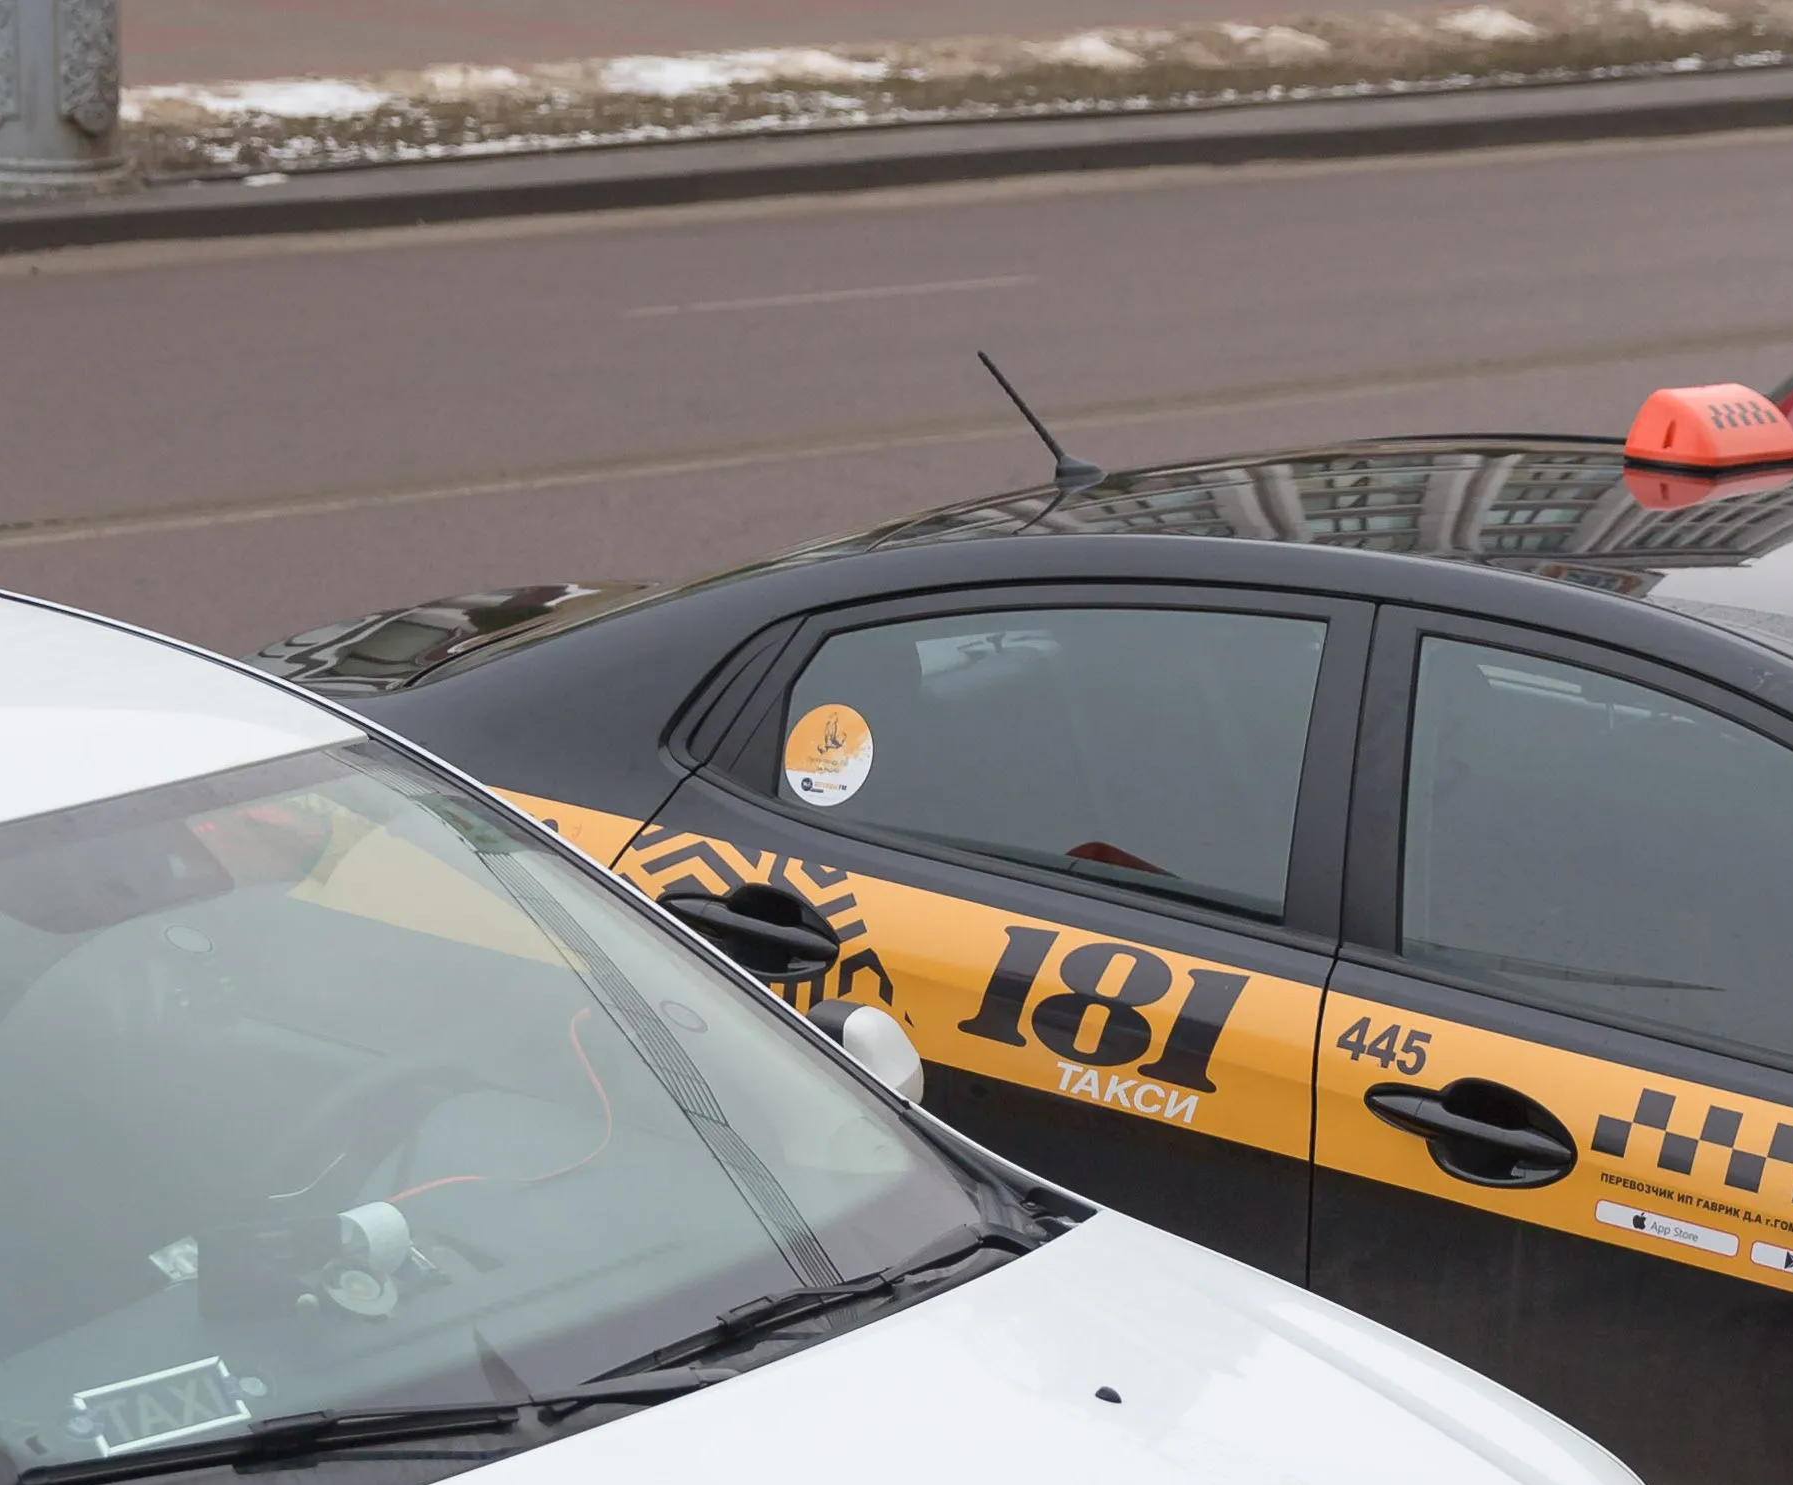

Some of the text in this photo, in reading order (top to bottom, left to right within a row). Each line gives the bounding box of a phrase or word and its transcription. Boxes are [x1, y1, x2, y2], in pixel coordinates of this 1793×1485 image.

[957, 924, 1251, 1094] 181
[1336, 1016, 1432, 1075] 445
[1055, 1061, 1201, 1125] ТАКСИ
[1600, 1172, 1674, 1201] ПЕРЕВОЗЧИК
[1677, 1192, 1693, 1206] ИП
[1696, 1197, 1740, 1218] ГАВРИК
[1650, 1221, 1699, 1243] App Store
[96, 1374, 234, 1443] TAXI
